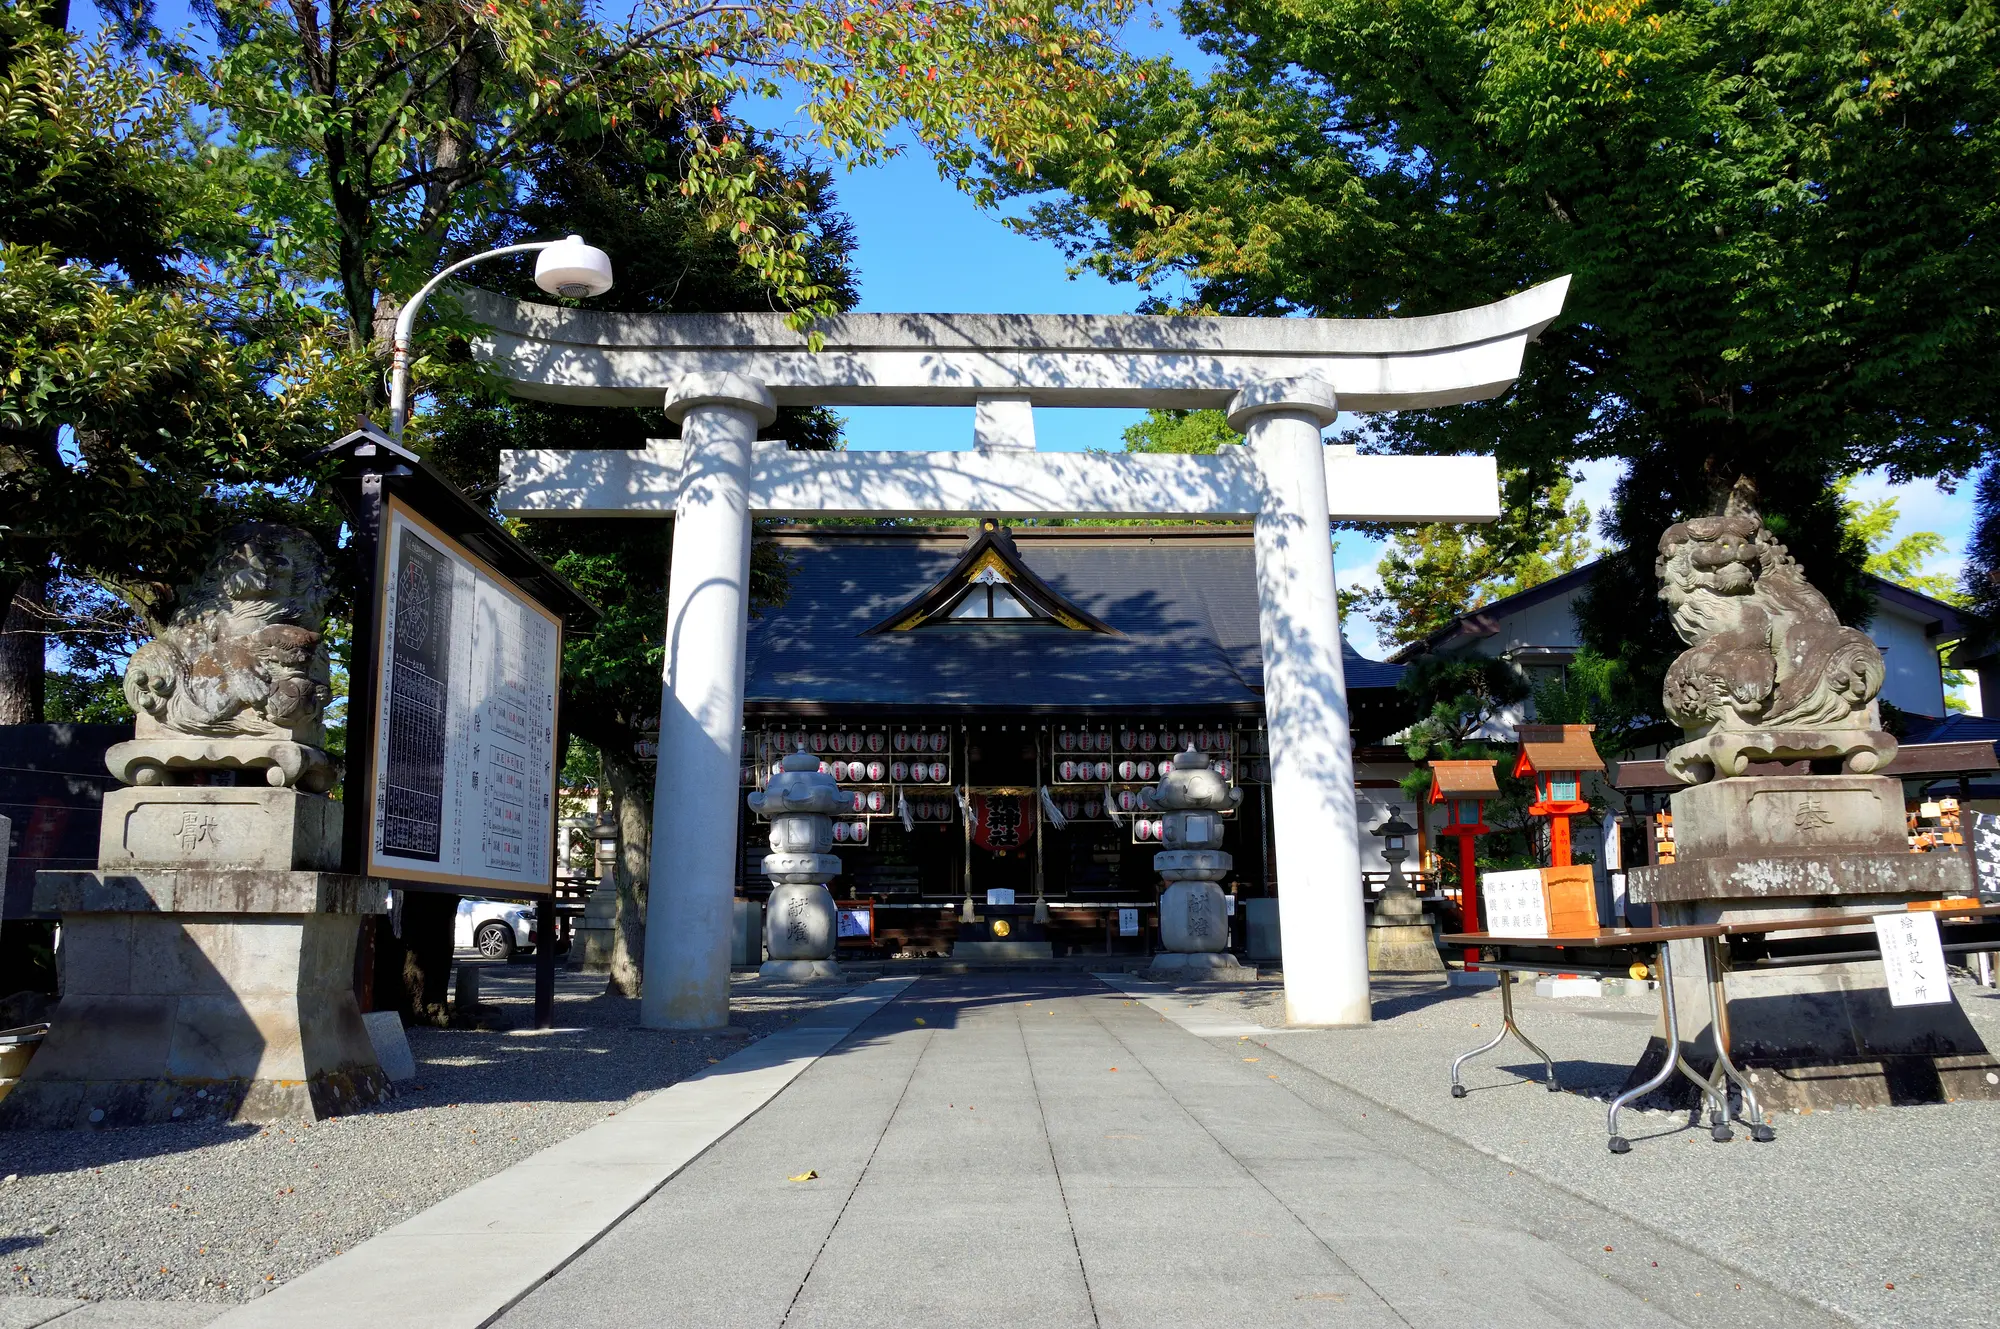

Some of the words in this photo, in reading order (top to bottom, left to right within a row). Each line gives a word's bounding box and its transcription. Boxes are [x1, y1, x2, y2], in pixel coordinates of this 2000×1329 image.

[542, 694, 552, 811] 厄除祈願
[375, 772, 386, 854] 稲積神社
[1794, 796, 1835, 830] 奉
[1487, 878, 1540, 894] 熊本・大分
[1489, 896, 1541, 911] 震災神社
[787, 897, 810, 943] 献燈
[1491, 913, 1544, 928] 復興義援金
[1900, 916, 1928, 1000] 絵馬記入所
